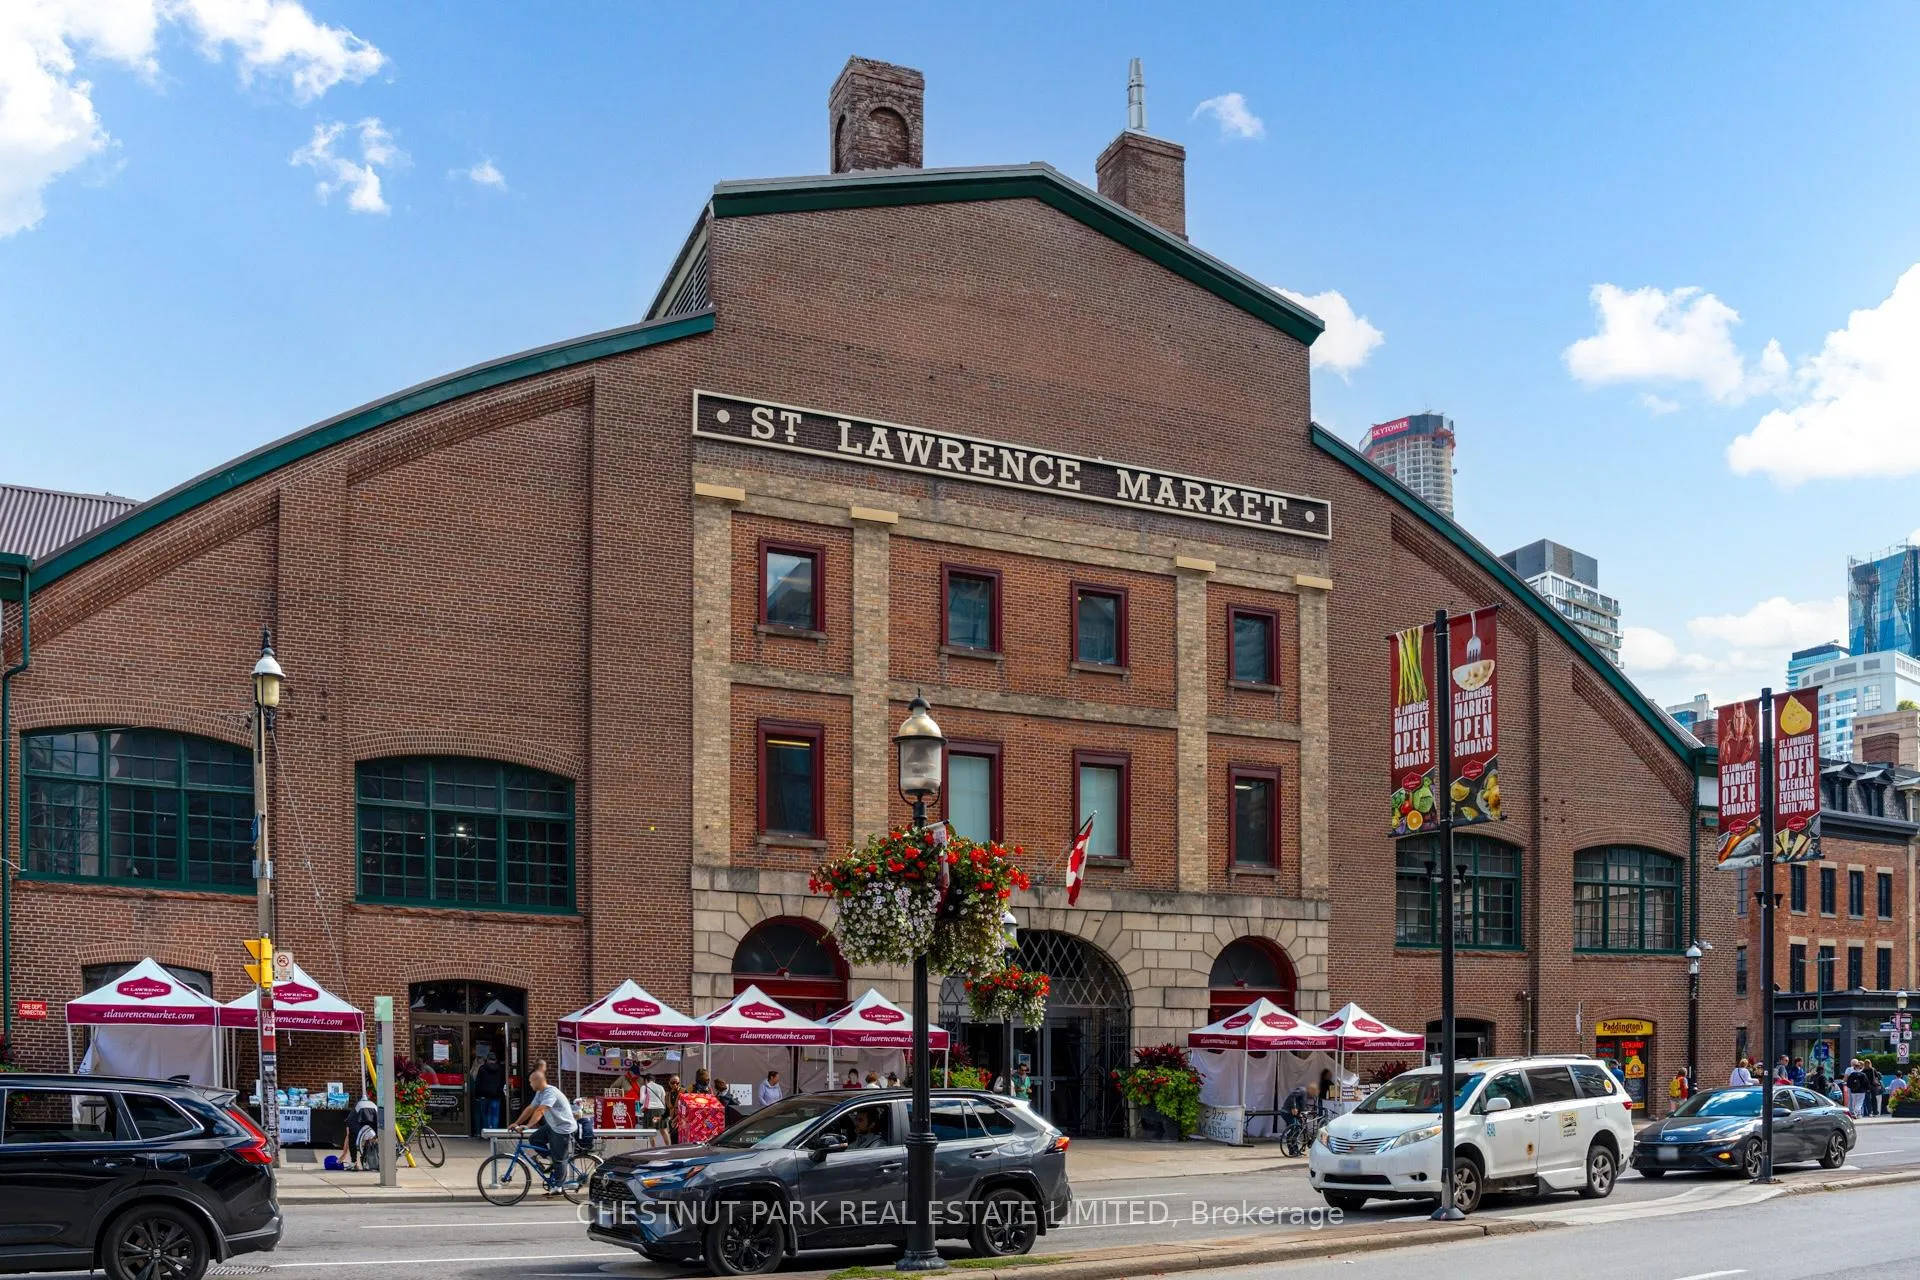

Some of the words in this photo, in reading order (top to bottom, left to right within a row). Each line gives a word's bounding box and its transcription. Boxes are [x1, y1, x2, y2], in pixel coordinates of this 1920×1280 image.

[838, 421, 1080, 490] LAWRENCE
[1117, 469, 1287, 525] MARKET
[1455, 697, 1492, 720] MARKET
[1395, 711, 1429, 733] MARKET
[1455, 715, 1492, 743] OPEN
[1395, 728, 1429, 755] OPEN
[1455, 737, 1492, 757] SUNDAYS
[1395, 750, 1429, 769] SUNDAYS
[1779, 744, 1814, 761] MARKET
[1722, 769, 1756, 787] MARKET
[1779, 758, 1814, 780] OPEN
[1779, 776, 1814, 791] WEEKDAY
[1722, 784, 1756, 804] OPEN
[1779, 788, 1815, 804] EVENINGS
[1722, 802, 1756, 816] SUNDAYS
[1779, 801, 1798, 815] UNTIL
[1799, 800, 1815, 813] 7PM
[103, 1009, 195, 1020] stlawrencemarket.com
[609, 1027, 689, 1038] stlawrencemarket.com
[740, 1030, 816, 1041] stlawrencemarket.com
[1603, 1022, 1643, 1033] Paddington's
